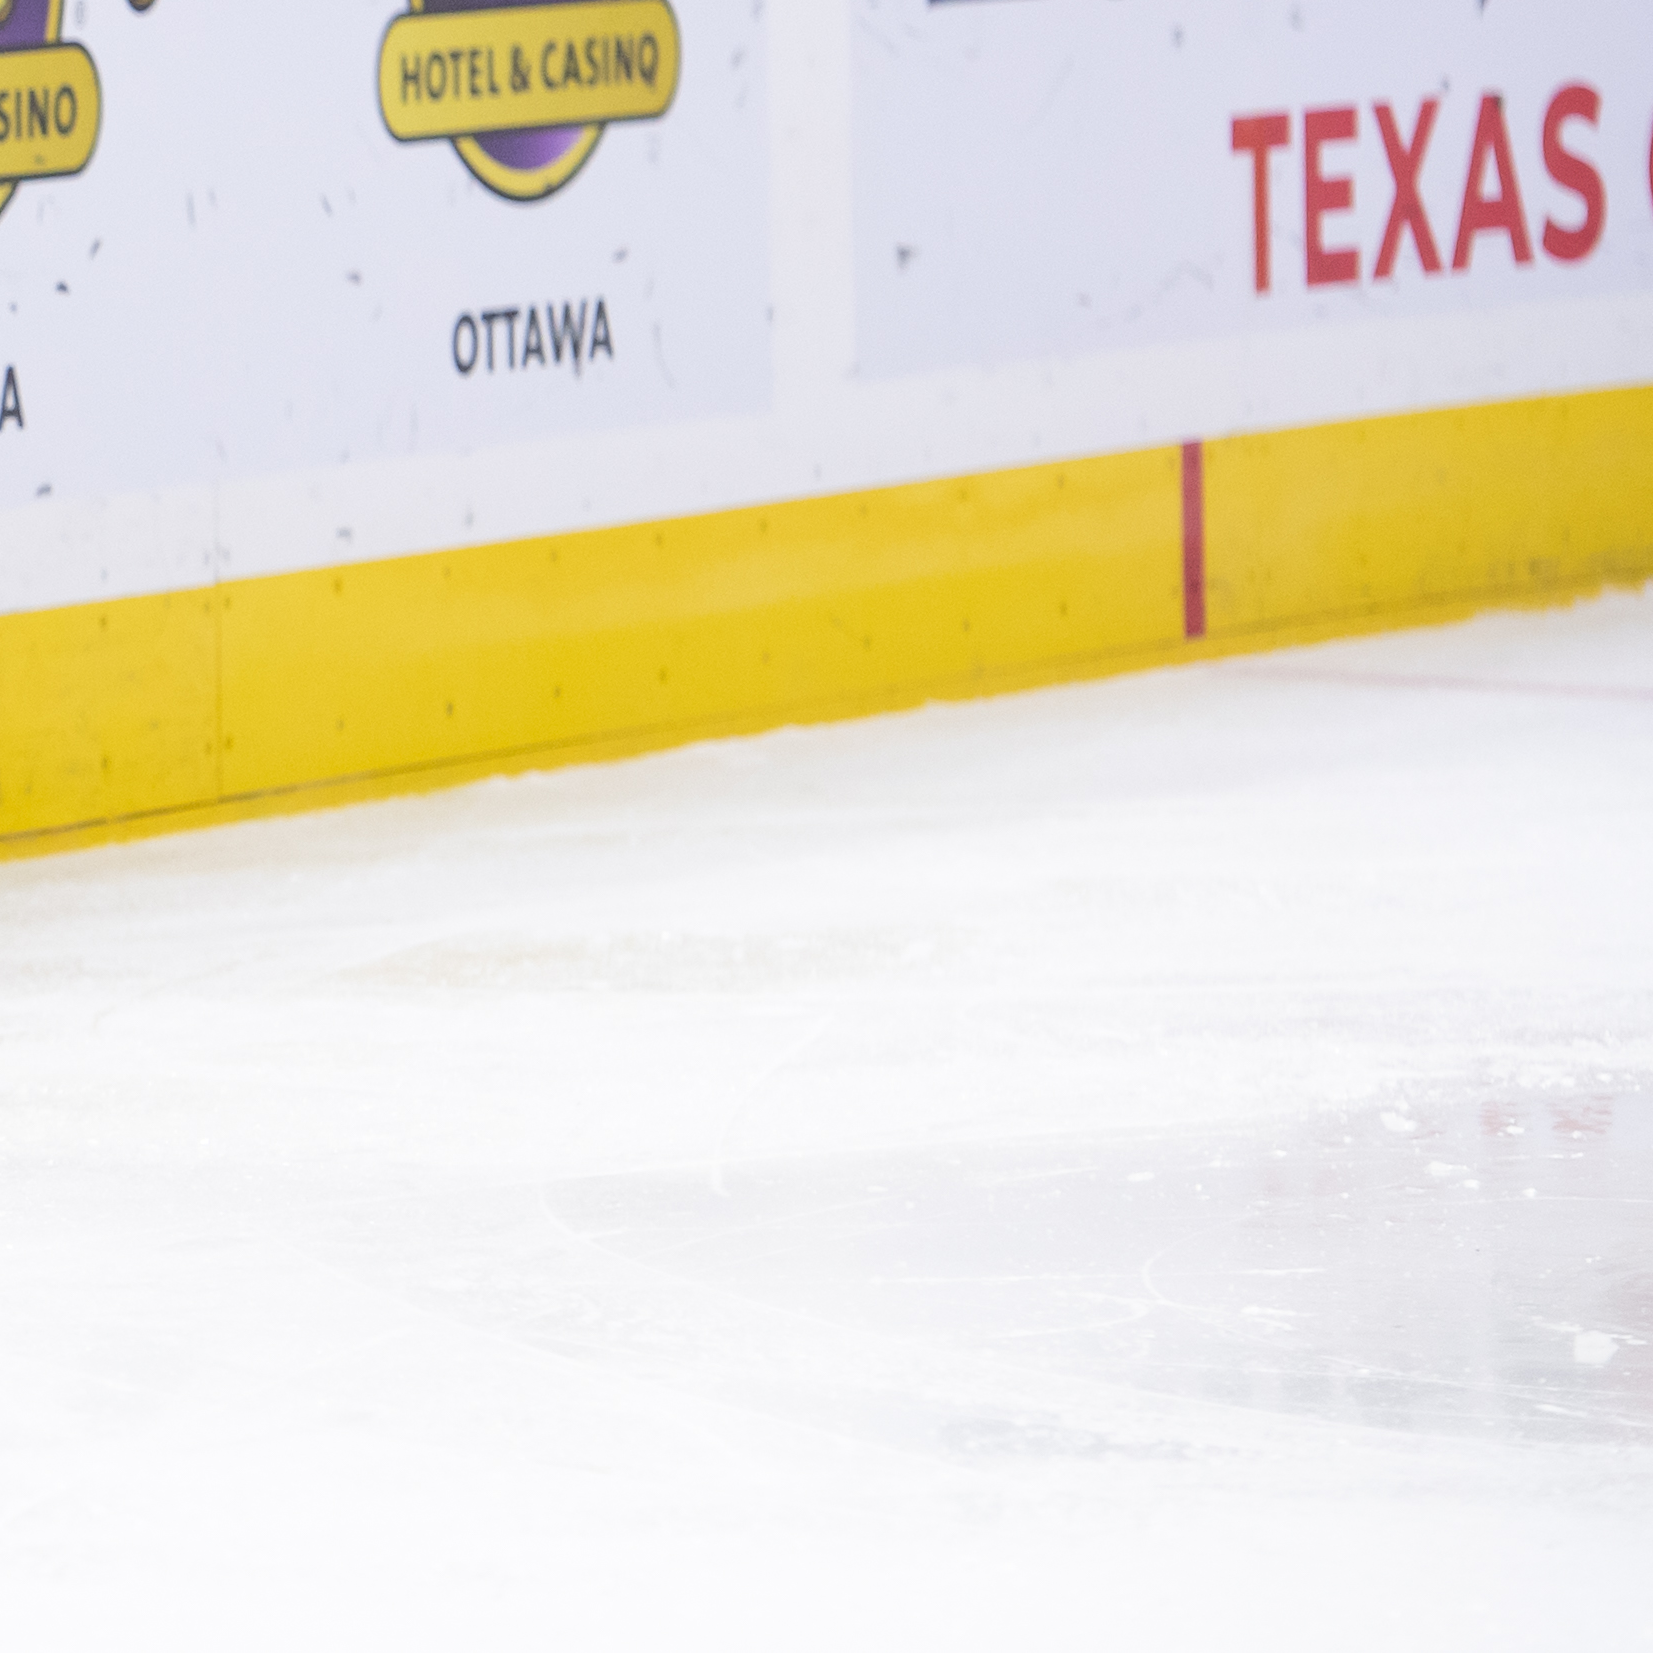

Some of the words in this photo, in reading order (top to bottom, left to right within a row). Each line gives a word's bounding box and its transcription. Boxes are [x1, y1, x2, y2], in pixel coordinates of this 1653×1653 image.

[399, 48, 502, 105] HOTEL
[509, 44, 532, 94] &
[540, 32, 660, 92] CASINO
[1231, 81, 1608, 296] TEXAS
[452, 296, 615, 377] OTTAWA
